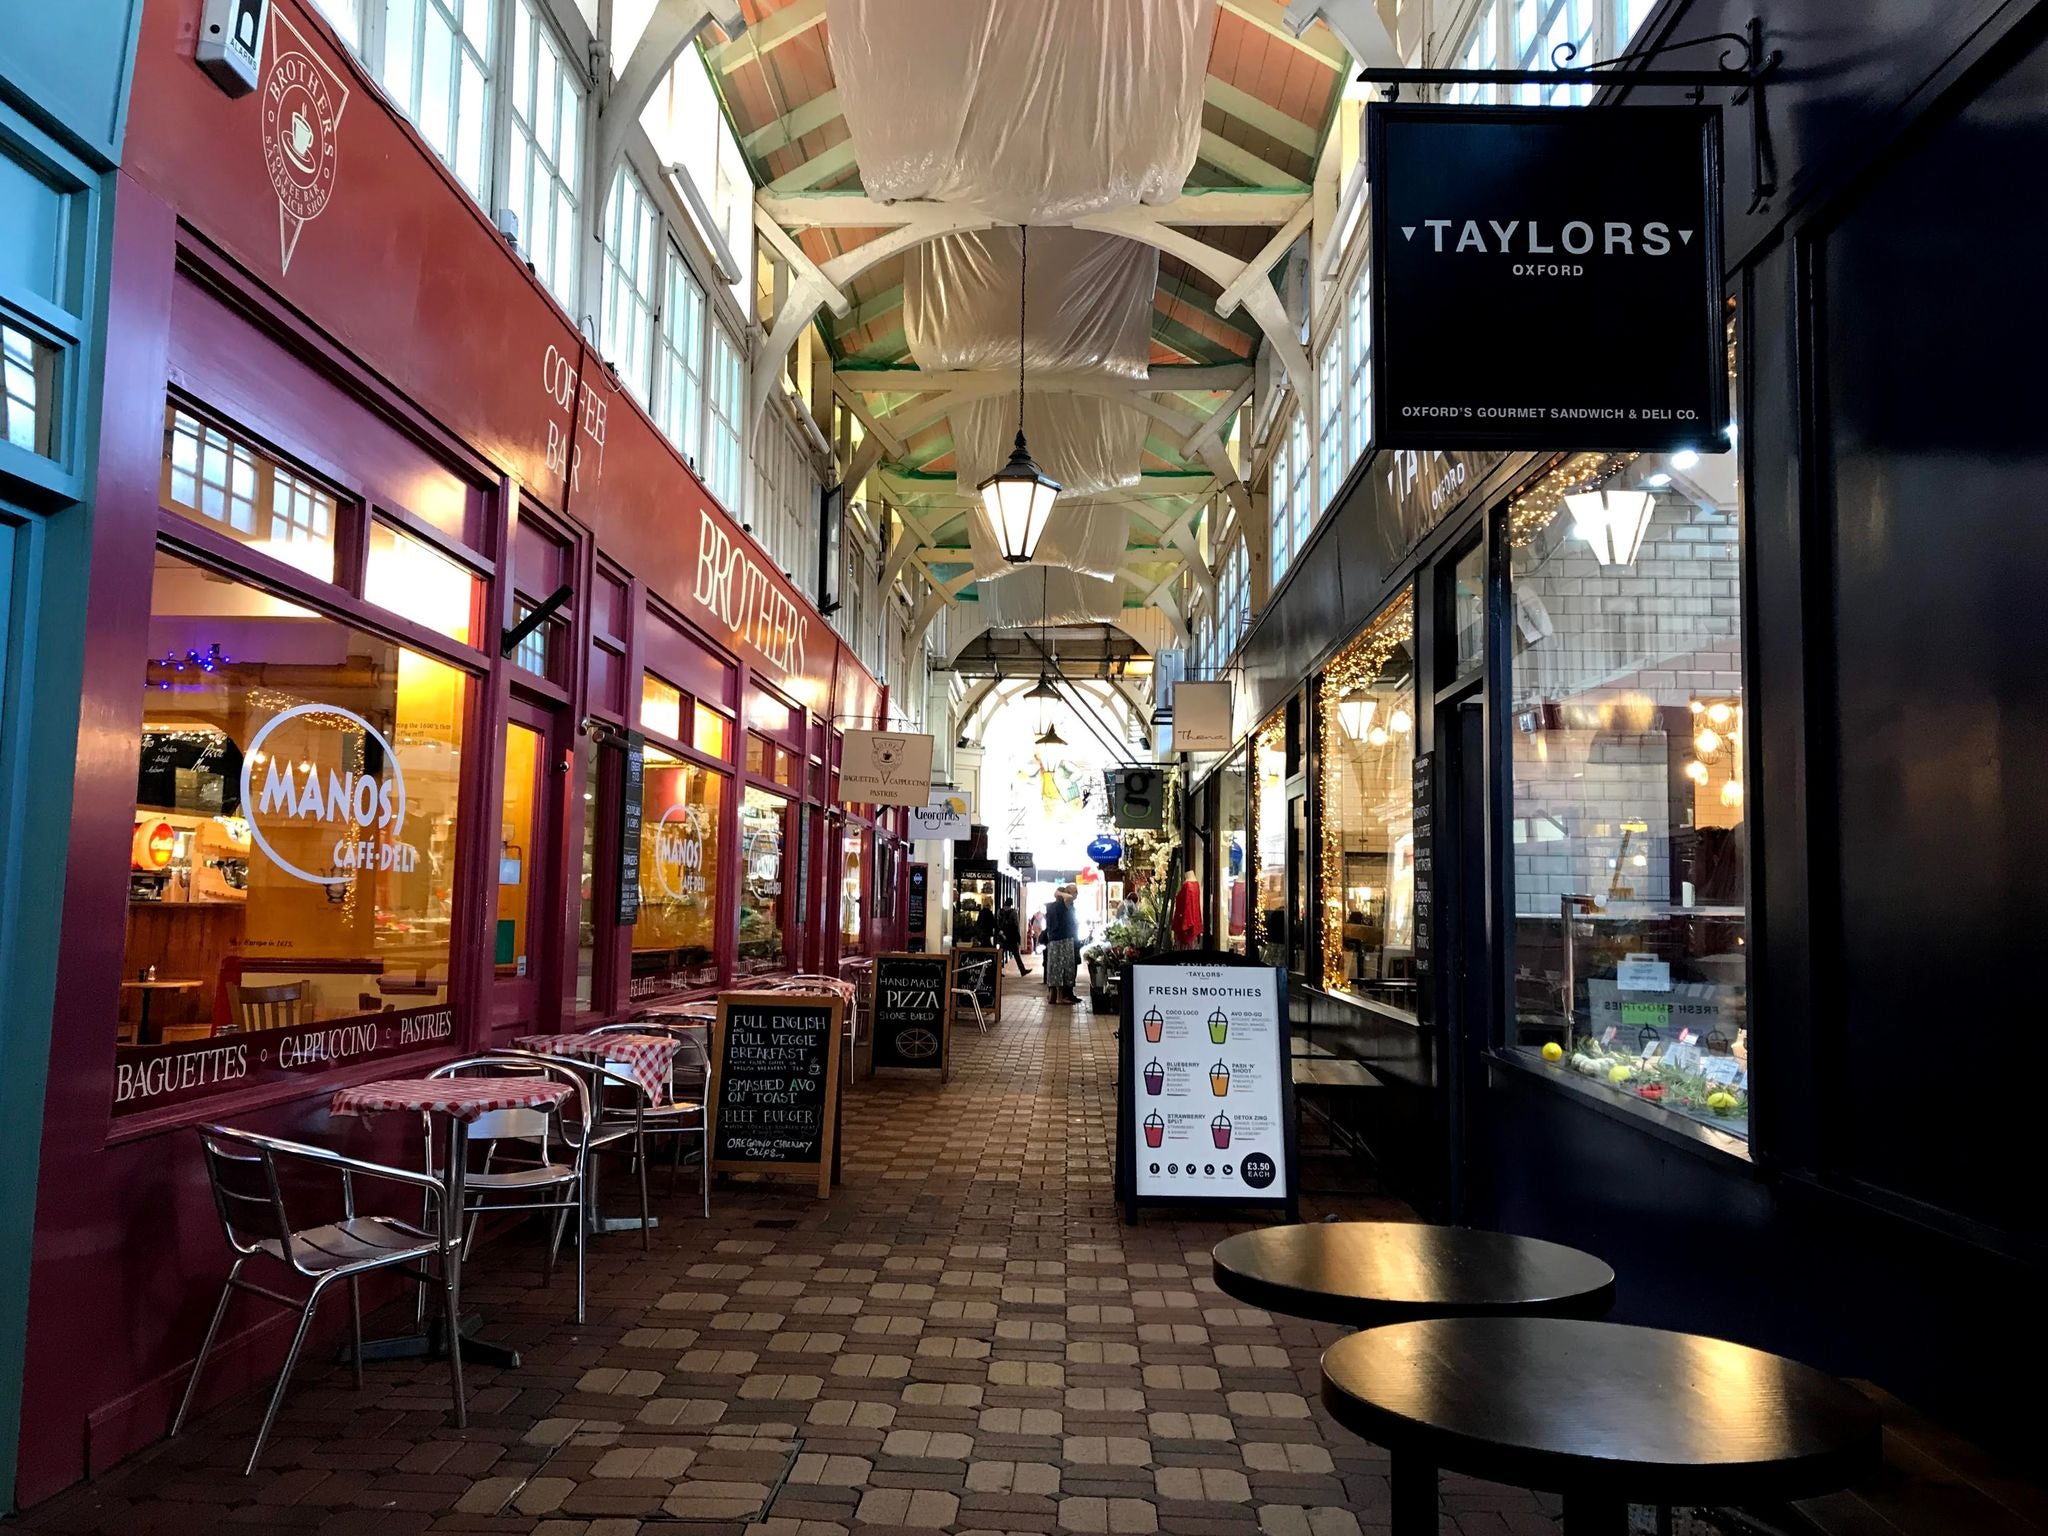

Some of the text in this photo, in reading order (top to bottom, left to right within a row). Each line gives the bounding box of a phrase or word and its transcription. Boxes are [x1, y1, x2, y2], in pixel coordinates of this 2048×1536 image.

[230, 37, 258, 71] ALARMS
[269, 59, 333, 157] BROTHERS
[265, 135, 326, 216] SANDWICH SHOP
[272, 143, 320, 202] COFFEE BAR
[1424, 219, 1671, 256] TAYLORS
[1512, 263, 1584, 276] OXFORD
[543, 344, 607, 446] COFFEE
[1401, 406, 1699, 420] OXFORD'S GOURMET SANDWICH & DELI CO.
[544, 418, 581, 493] BAR
[1431, 462, 1465, 511] OXFORD
[693, 509, 808, 679] BROTHERS
[259, 754, 393, 830] MANOS
[869, 789, 898, 798] PASTRIES
[661, 832, 701, 870] MANOS
[886, 990, 940, 1009] PIZZA
[1148, 986, 1262, 998] FRESH SMOOTHIES
[733, 1015, 826, 1030] FULL ENGLISH
[731, 1032, 818, 1046] FULL VEGGIE
[115, 1010, 452, 1103] BAGUETTES CAPPUCCINO PASTRIES
[730, 1046, 808, 1060] BREAKFAST
[728, 1078, 816, 1092] SMASHED AVO
[728, 1091, 798, 1104] ON TOAST
[725, 1109, 813, 1124] BEEF BURGER
[1247, 1162, 1270, 1171] £3.50
